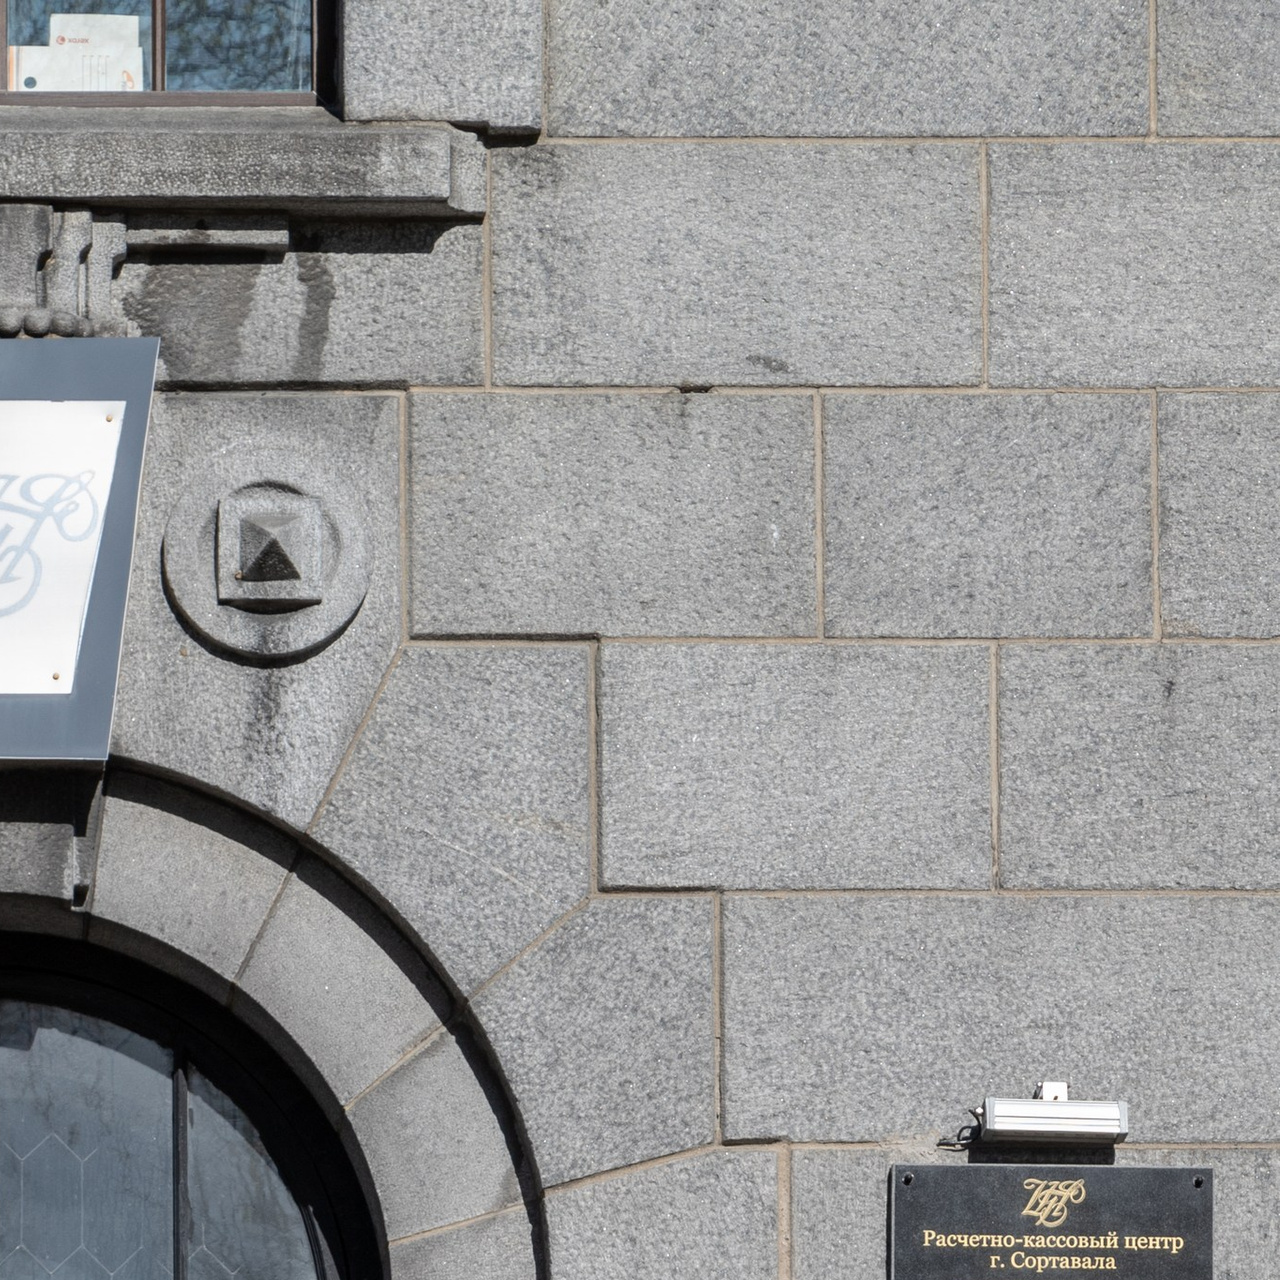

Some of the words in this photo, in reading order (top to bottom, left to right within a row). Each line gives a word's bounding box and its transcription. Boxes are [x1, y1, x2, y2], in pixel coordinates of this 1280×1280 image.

[922, 1229, 1119, 1250] Расчетно-кассовый
[1123, 1235, 1185, 1254] центр
[989, 1254, 1005, 1269] г.
[1010, 1251, 1117, 1273] Сортавала
